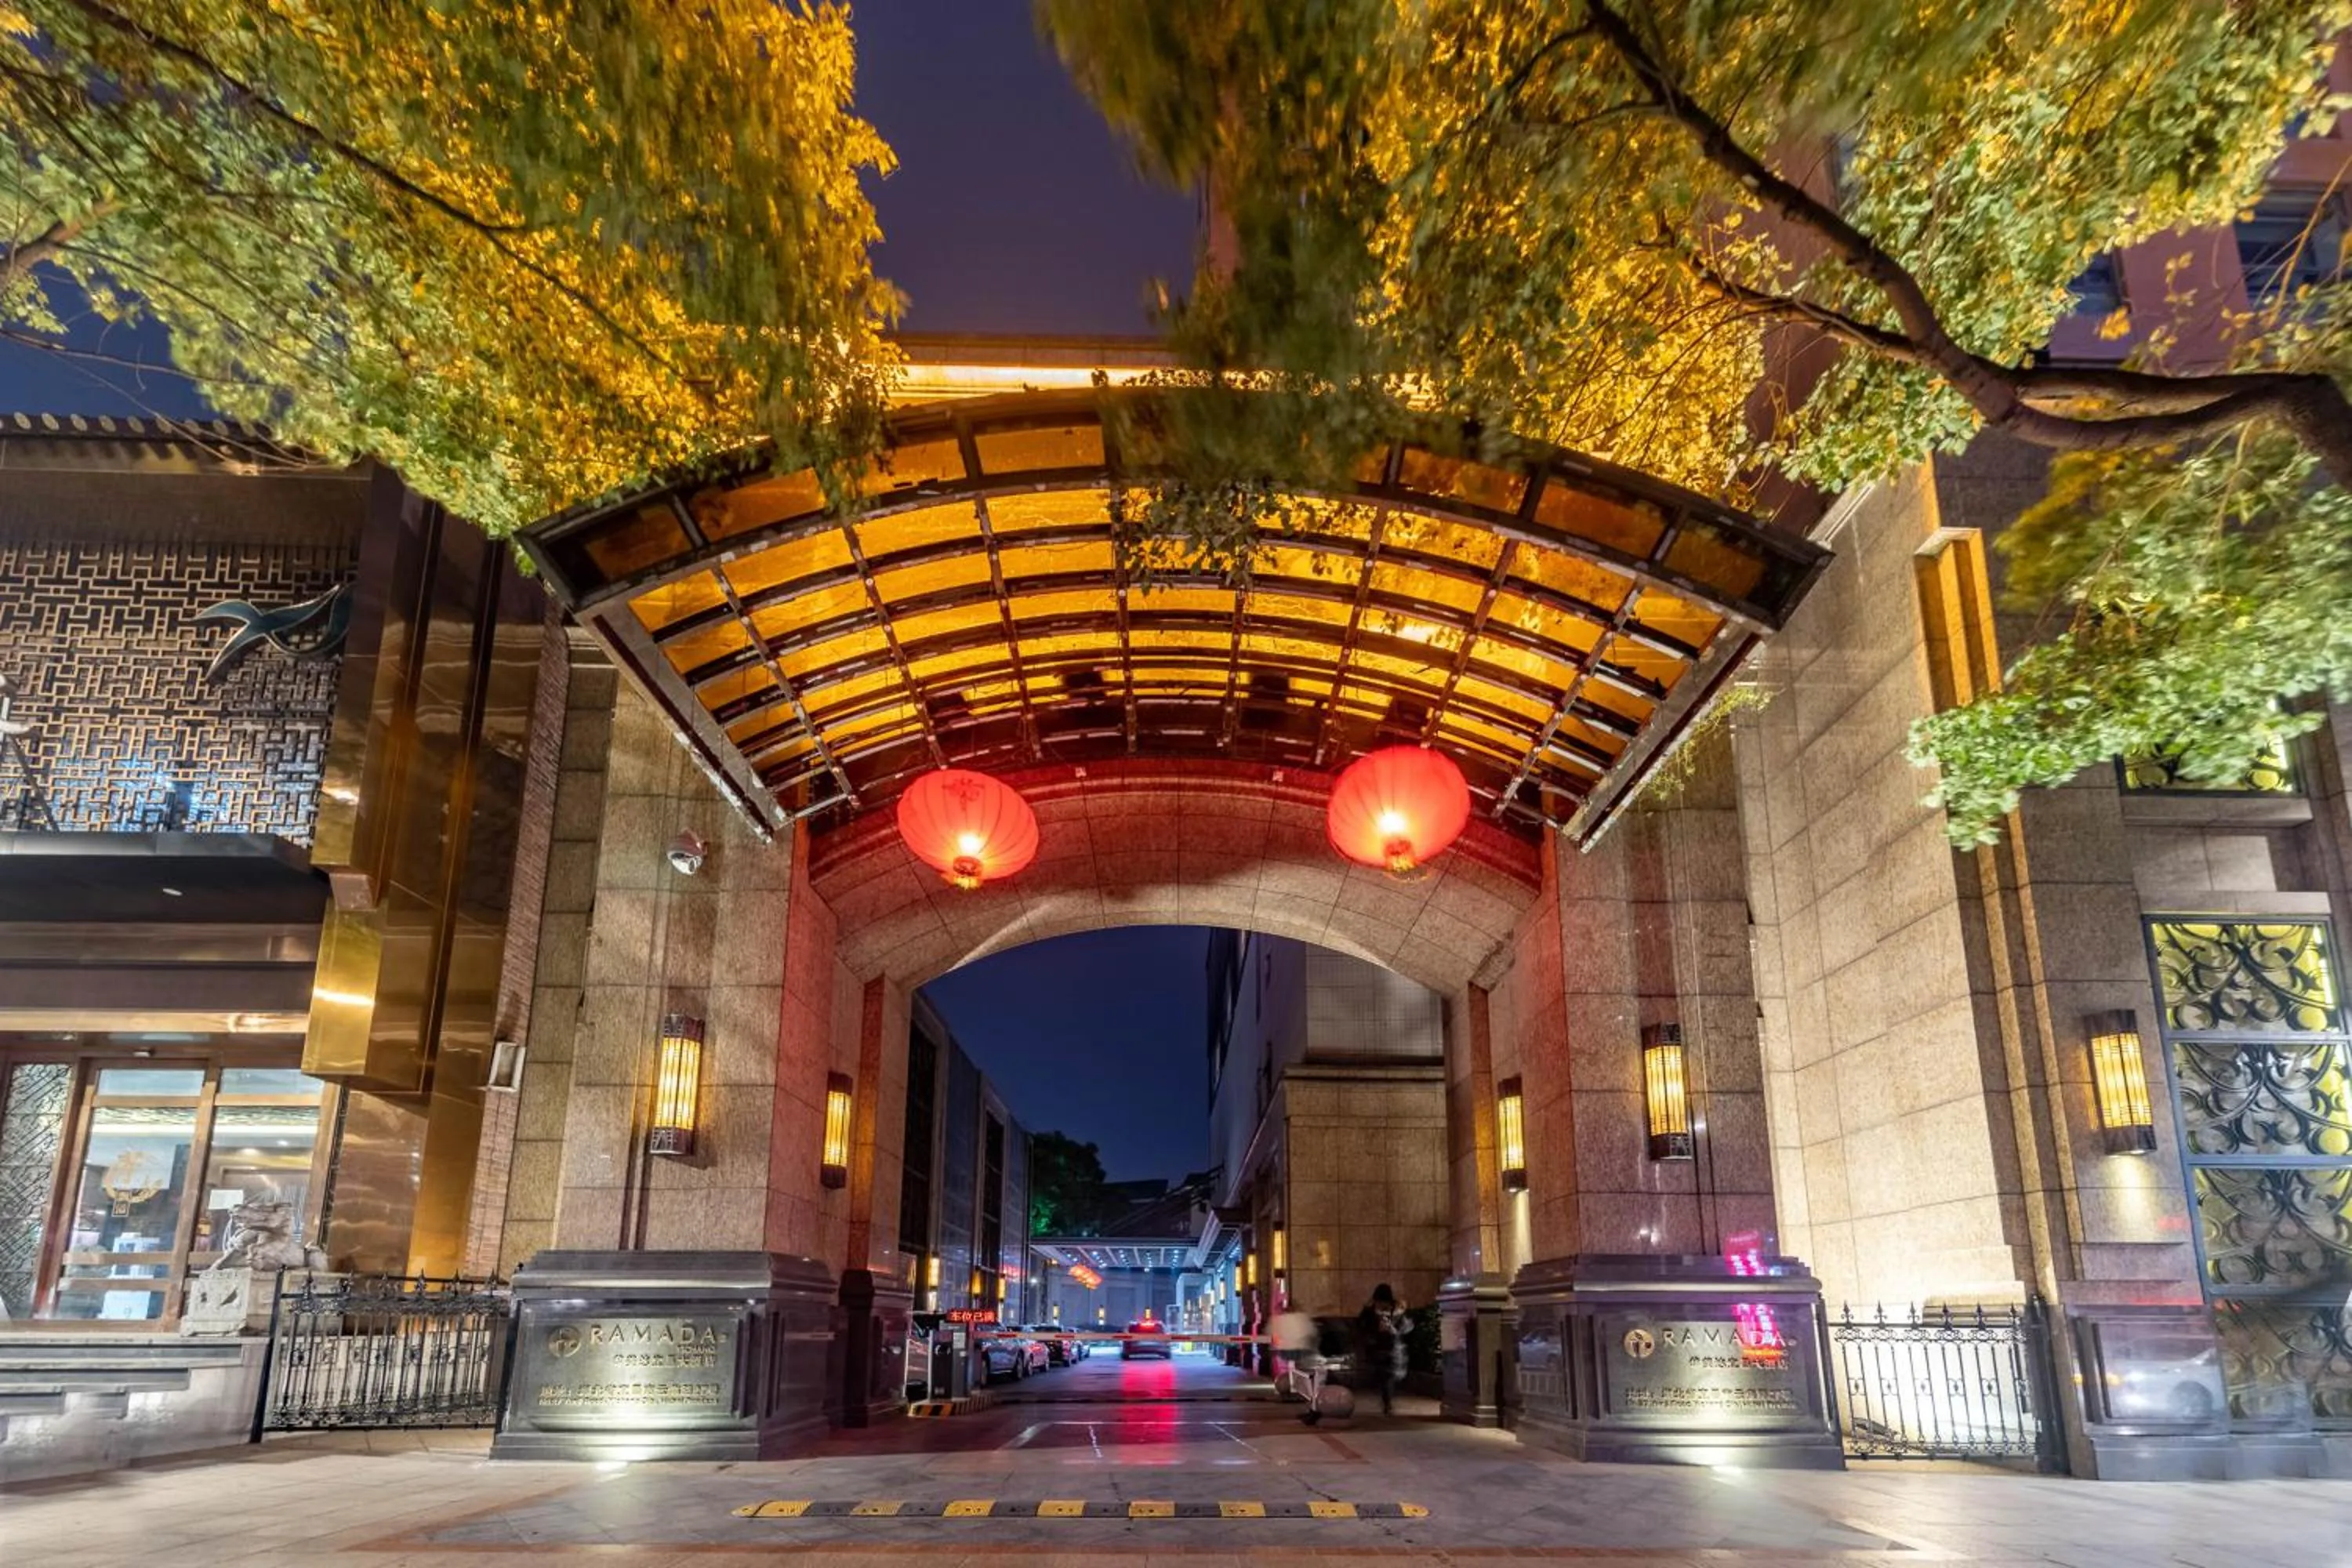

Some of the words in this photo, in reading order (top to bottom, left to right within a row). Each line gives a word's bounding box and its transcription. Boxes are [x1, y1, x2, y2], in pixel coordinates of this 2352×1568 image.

[949, 1310, 995, 1322] 车位已满
[590, 1323, 717, 1344] RAMADA
[1661, 1327, 1787, 1347] RAMADA
